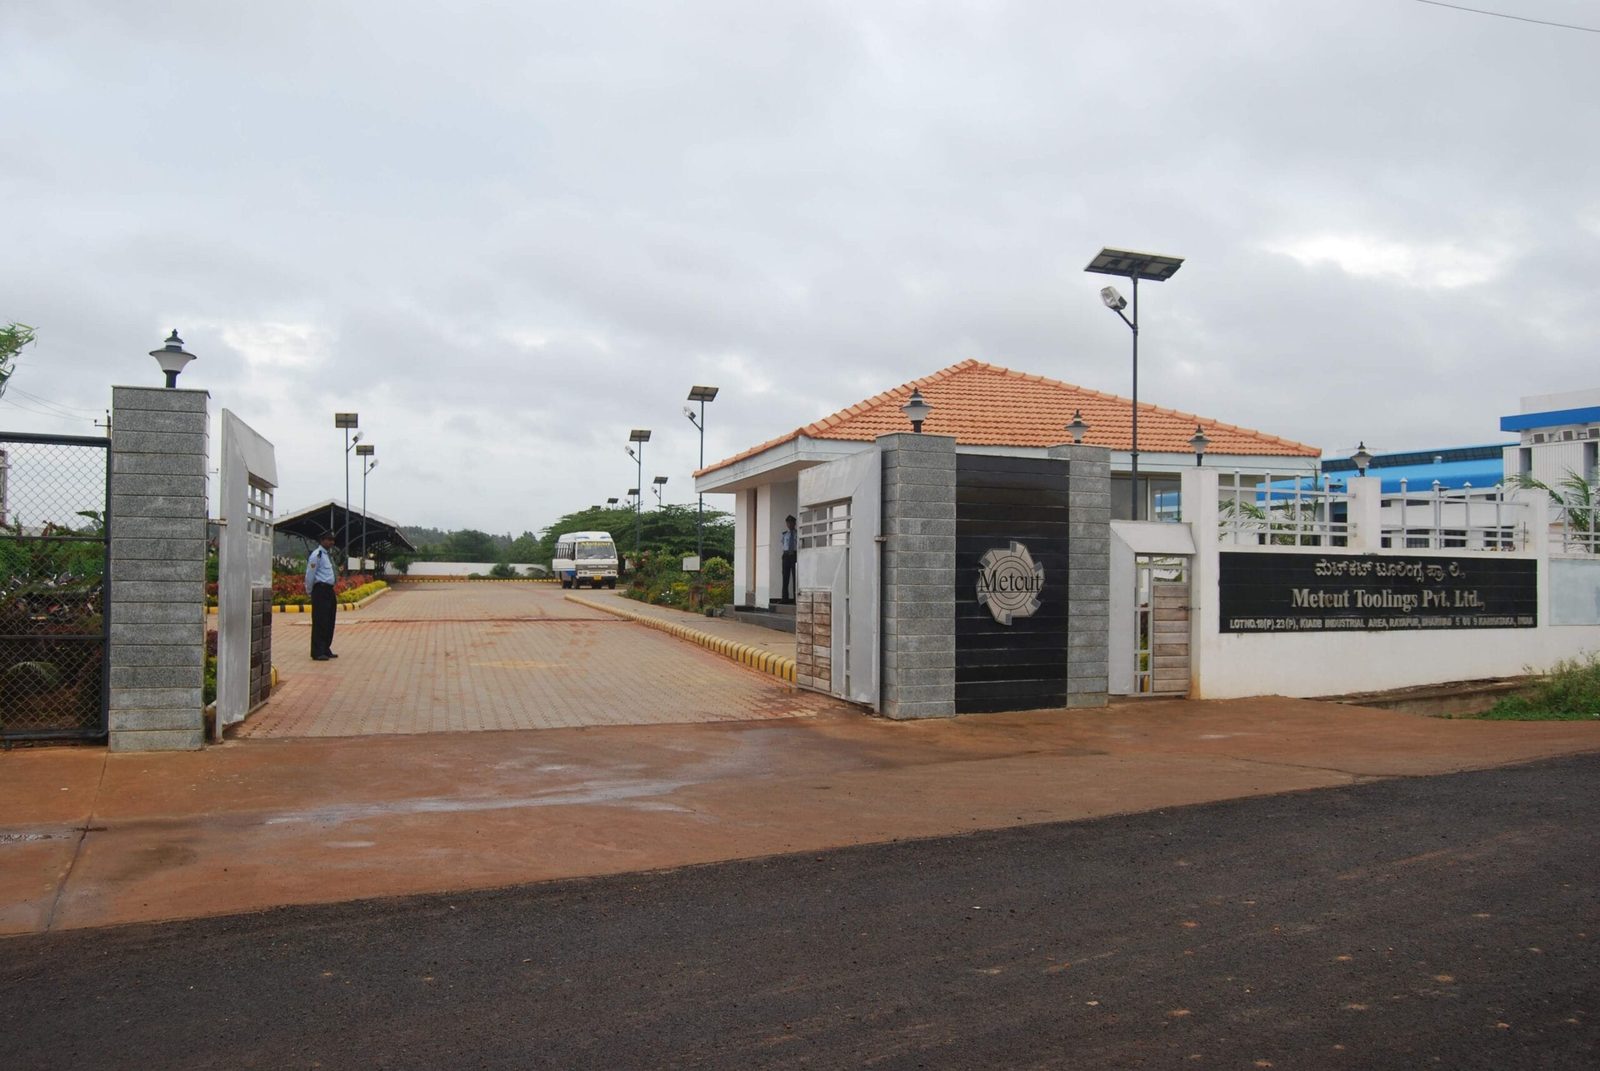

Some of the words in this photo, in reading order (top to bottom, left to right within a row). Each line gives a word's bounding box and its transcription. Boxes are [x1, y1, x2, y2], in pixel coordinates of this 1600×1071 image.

[978, 568, 1042, 592] Metcut
[1291, 588, 1350, 608] Metcut
[1354, 589, 1418, 612] Toolings
[1423, 590, 1450, 608] Pvt.
[1325, 617, 1365, 628] INDUSTRIAL
